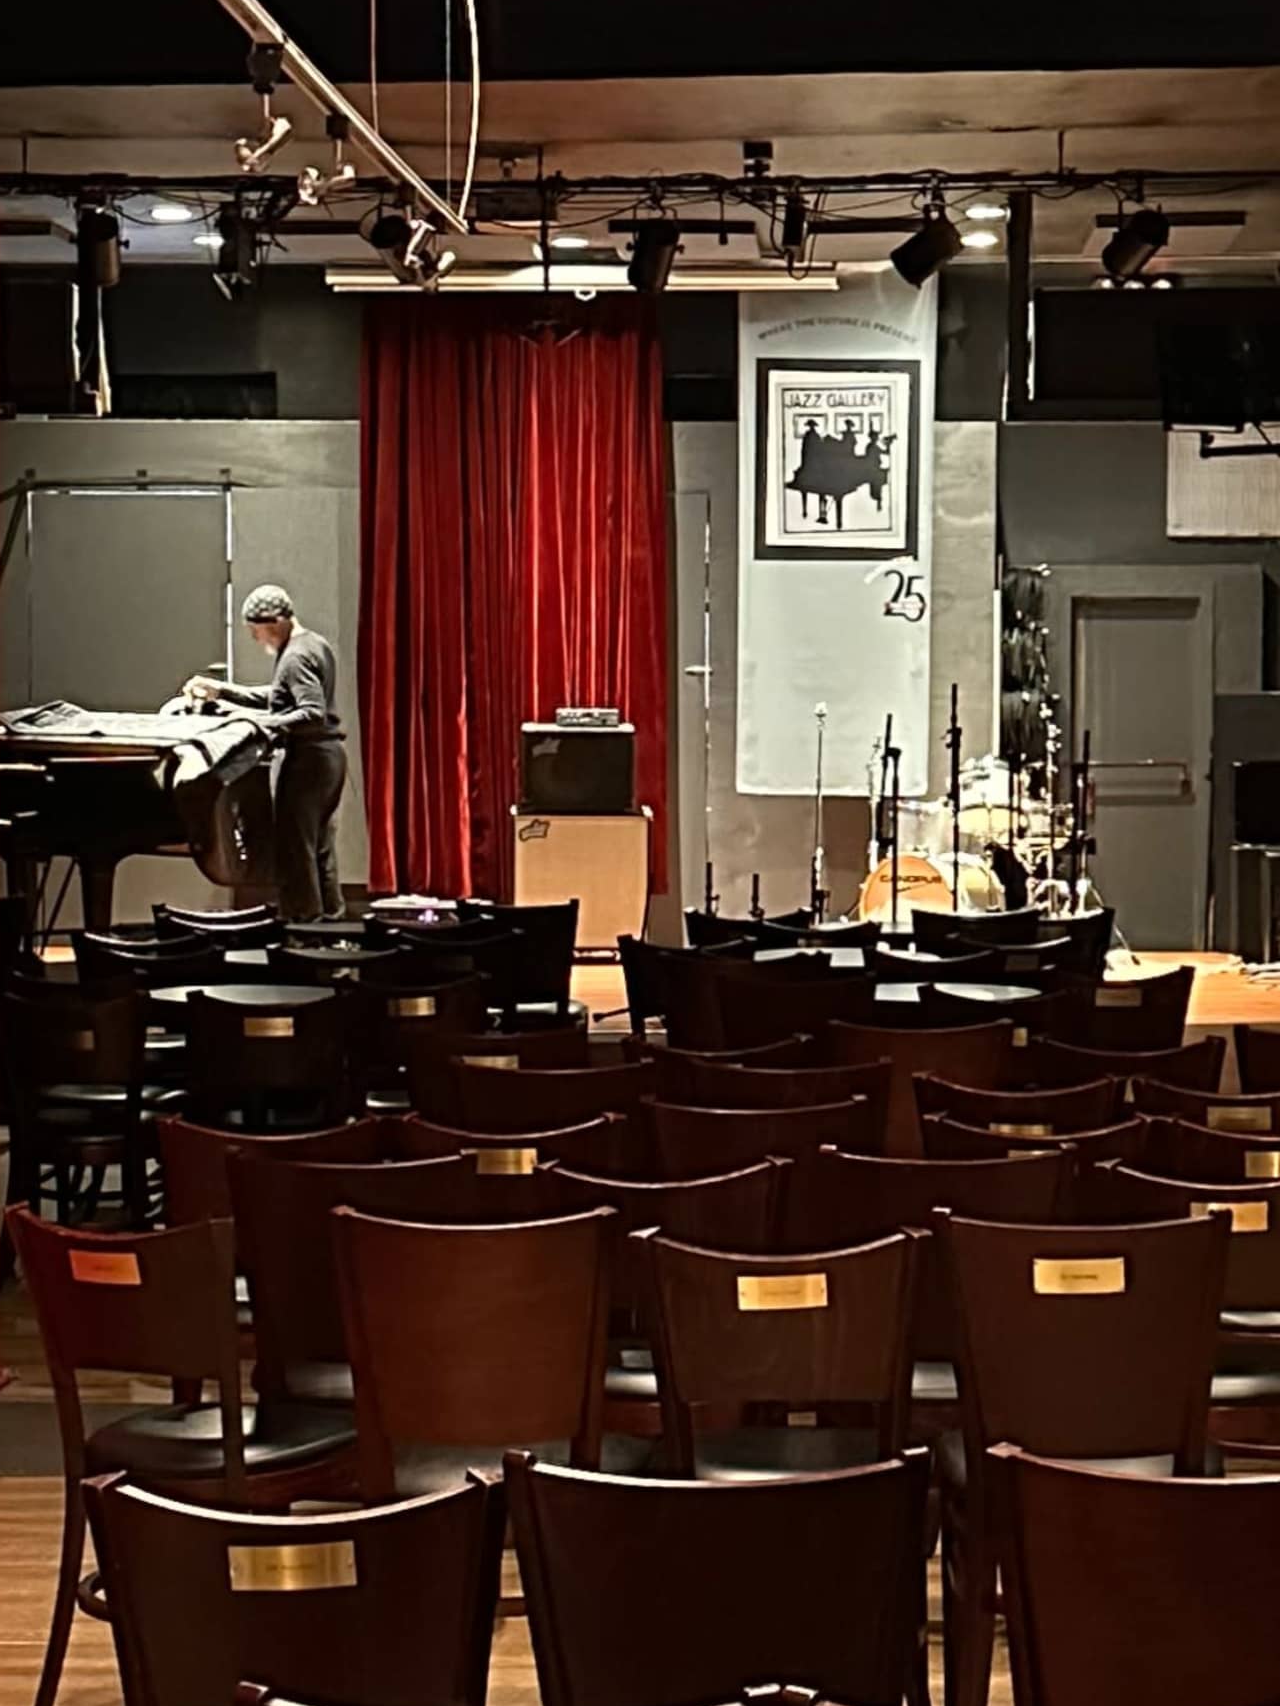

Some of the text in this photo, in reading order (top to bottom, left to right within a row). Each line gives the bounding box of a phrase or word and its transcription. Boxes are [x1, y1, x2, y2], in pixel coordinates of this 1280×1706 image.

[795, 317, 815, 329] THE
[784, 392, 885, 408] JAZZ GALLERY
[883, 569, 927, 623] 25
